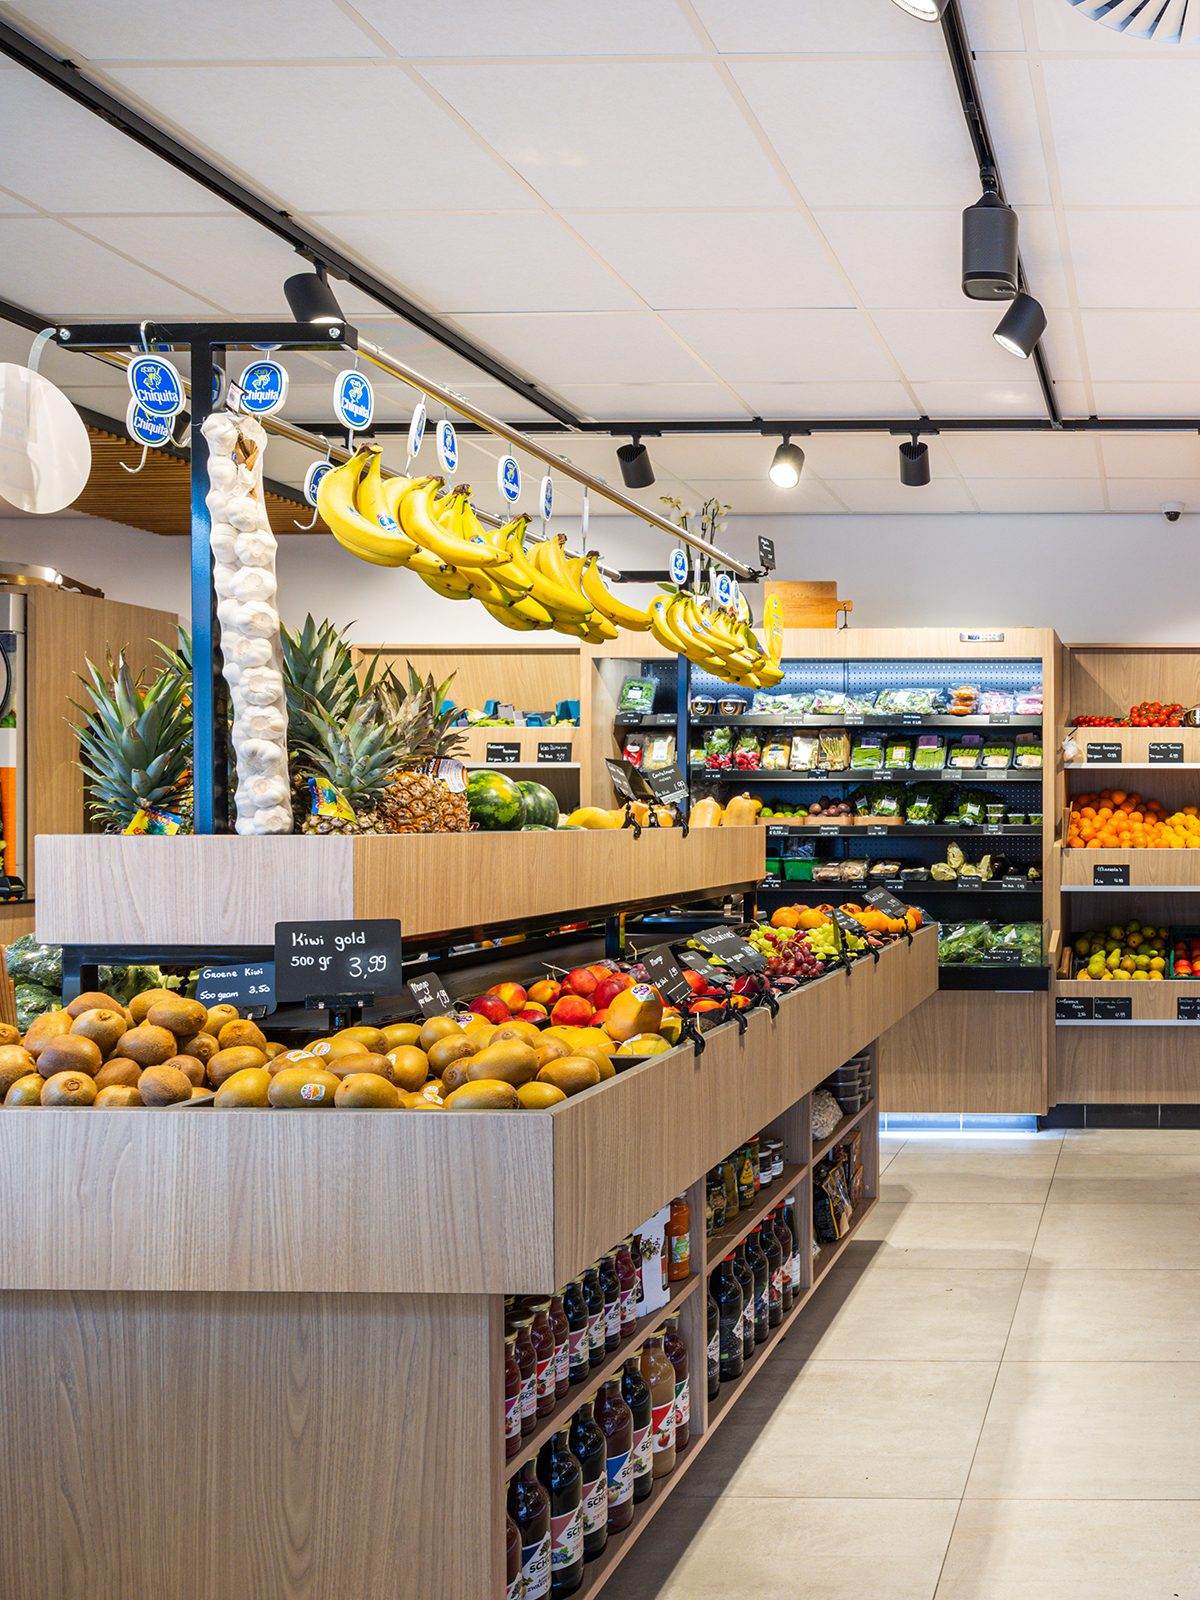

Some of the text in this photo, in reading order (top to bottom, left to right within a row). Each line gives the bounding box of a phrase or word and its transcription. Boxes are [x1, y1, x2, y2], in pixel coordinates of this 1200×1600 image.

[137, 389, 178, 405] Chiquita
[242, 390, 278, 404] Chiquita
[134, 417, 168, 437] Chiquita
[292, 931, 366, 951] Kiwi gold
[203, 967, 263, 980] Groene Kiwi
[290, 955, 387, 979] 500 gr 3,99
[217, 991, 239, 1002] gram
